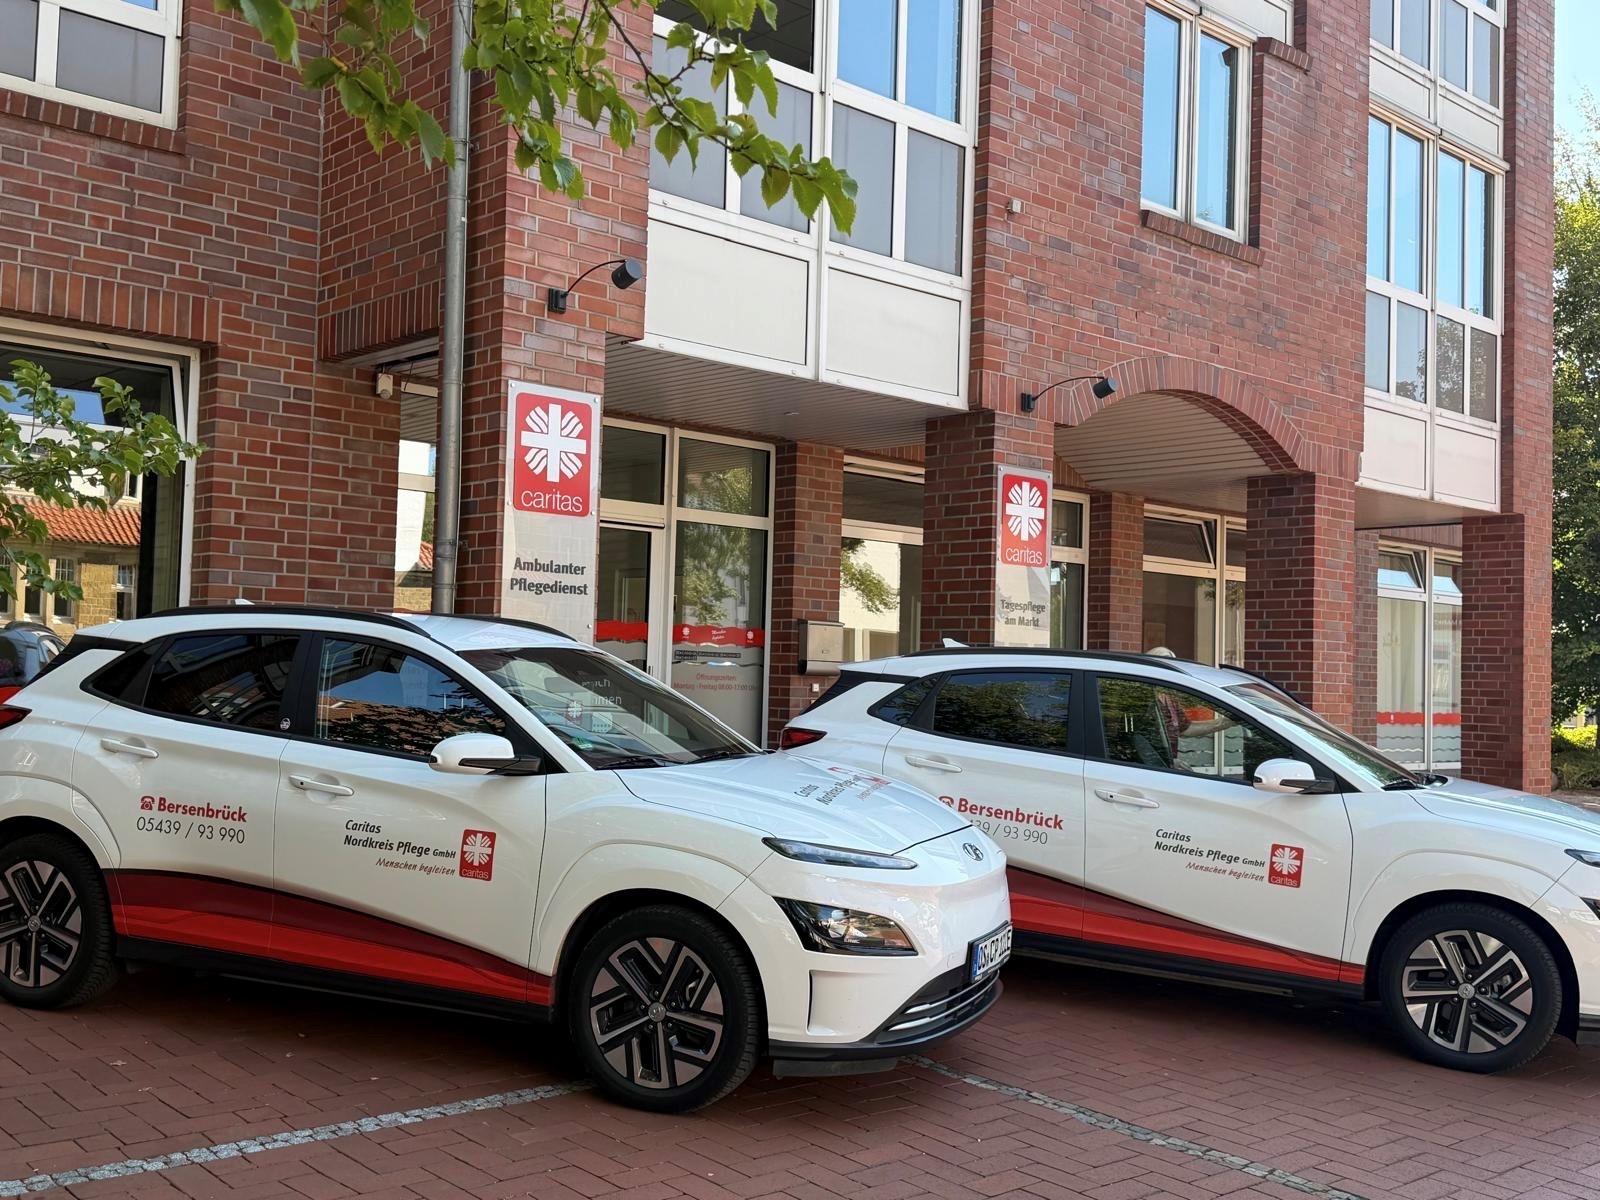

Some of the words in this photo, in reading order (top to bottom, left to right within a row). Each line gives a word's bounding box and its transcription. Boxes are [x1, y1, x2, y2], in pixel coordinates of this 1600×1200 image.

[521, 489, 583, 512] caritas
[1005, 545, 1043, 565] caritas
[513, 556, 587, 576] Ambulanter
[509, 577, 589, 596] Pflegedienst
[1000, 599, 1046, 614] Tagespflege
[1004, 616, 1017, 625] am
[1018, 616, 1040, 628] Markt
[157, 796, 248, 822] Bersenbrück
[957, 797, 1064, 830] Bersenbrück
[136, 816, 181, 835] 05439
[184, 822, 194, 839] /
[197, 824, 214, 840] 93
[219, 827, 245, 844] 990
[345, 819, 382, 834] Caritas
[1003, 825, 1019, 840] 93
[1023, 828, 1048, 845] 990
[1155, 828, 1191, 843] Caritas
[343, 834, 394, 851] Nordkreis
[396, 841, 431, 858] Pflege
[432, 848, 457, 859] GmbH
[1154, 841, 1204, 857] Nordkreis
[1206, 849, 1240, 865] Pflege
[1242, 857, 1266, 868] GmbH
[375, 857, 417, 870] Menschen
[419, 862, 456, 876] begleiten
[461, 867, 490, 880] caritas
[1185, 861, 1227, 876] Menschen
[1228, 869, 1265, 882] begleiten
[1270, 874, 1298, 887] caritas
